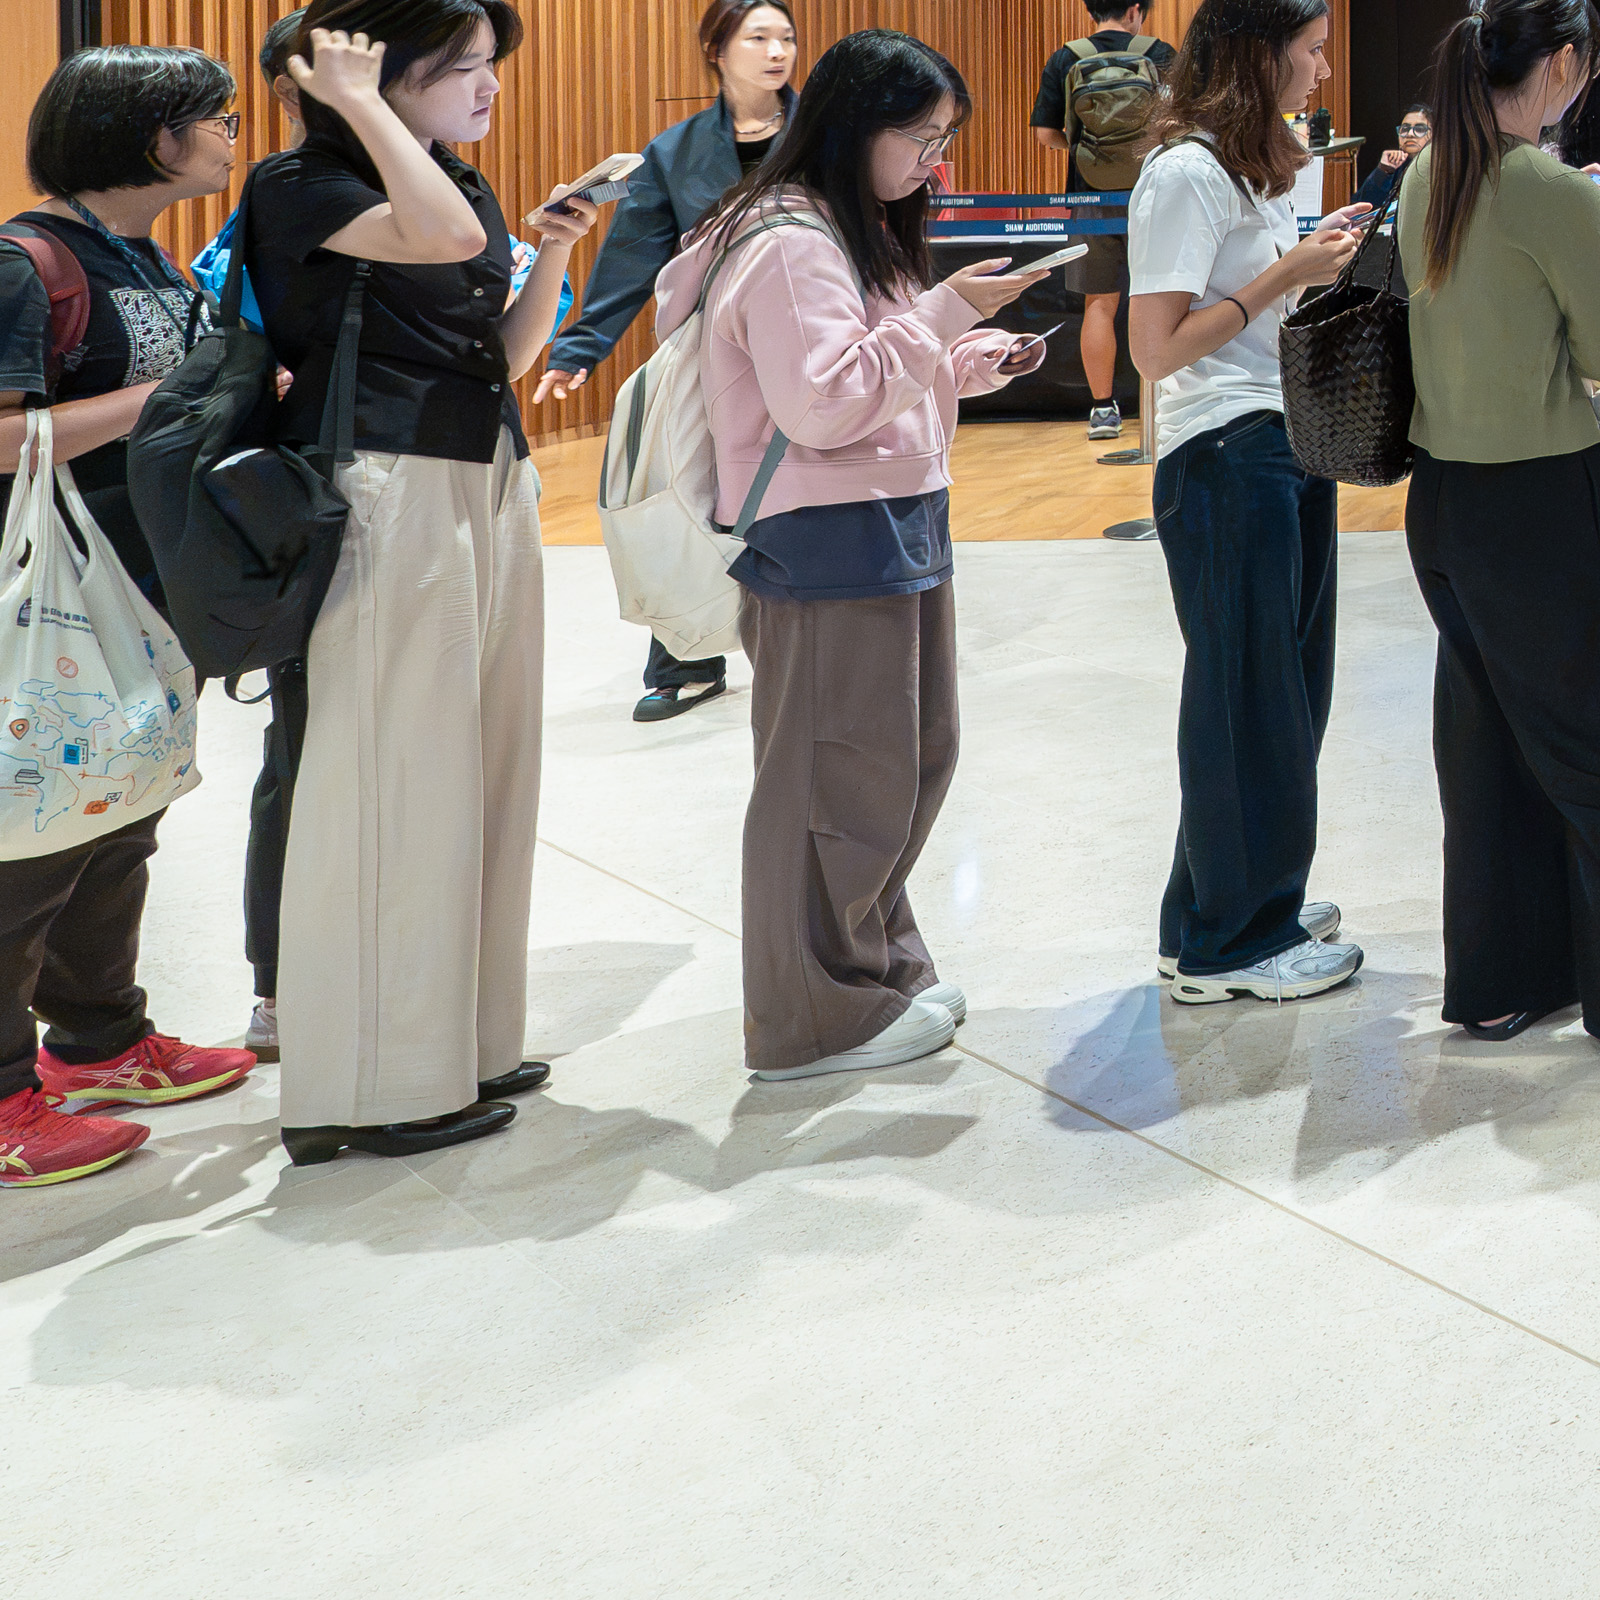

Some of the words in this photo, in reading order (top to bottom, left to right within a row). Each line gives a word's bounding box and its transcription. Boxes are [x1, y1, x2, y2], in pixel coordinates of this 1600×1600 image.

[940, 197, 975, 206] AUDITORIUM
[1067, 195, 1101, 205] AUDITORIUM
[1004, 223, 1024, 233] SHAW
[1025, 222, 1065, 233] AUDITORIUM
[1297, 220, 1308, 230] AW
